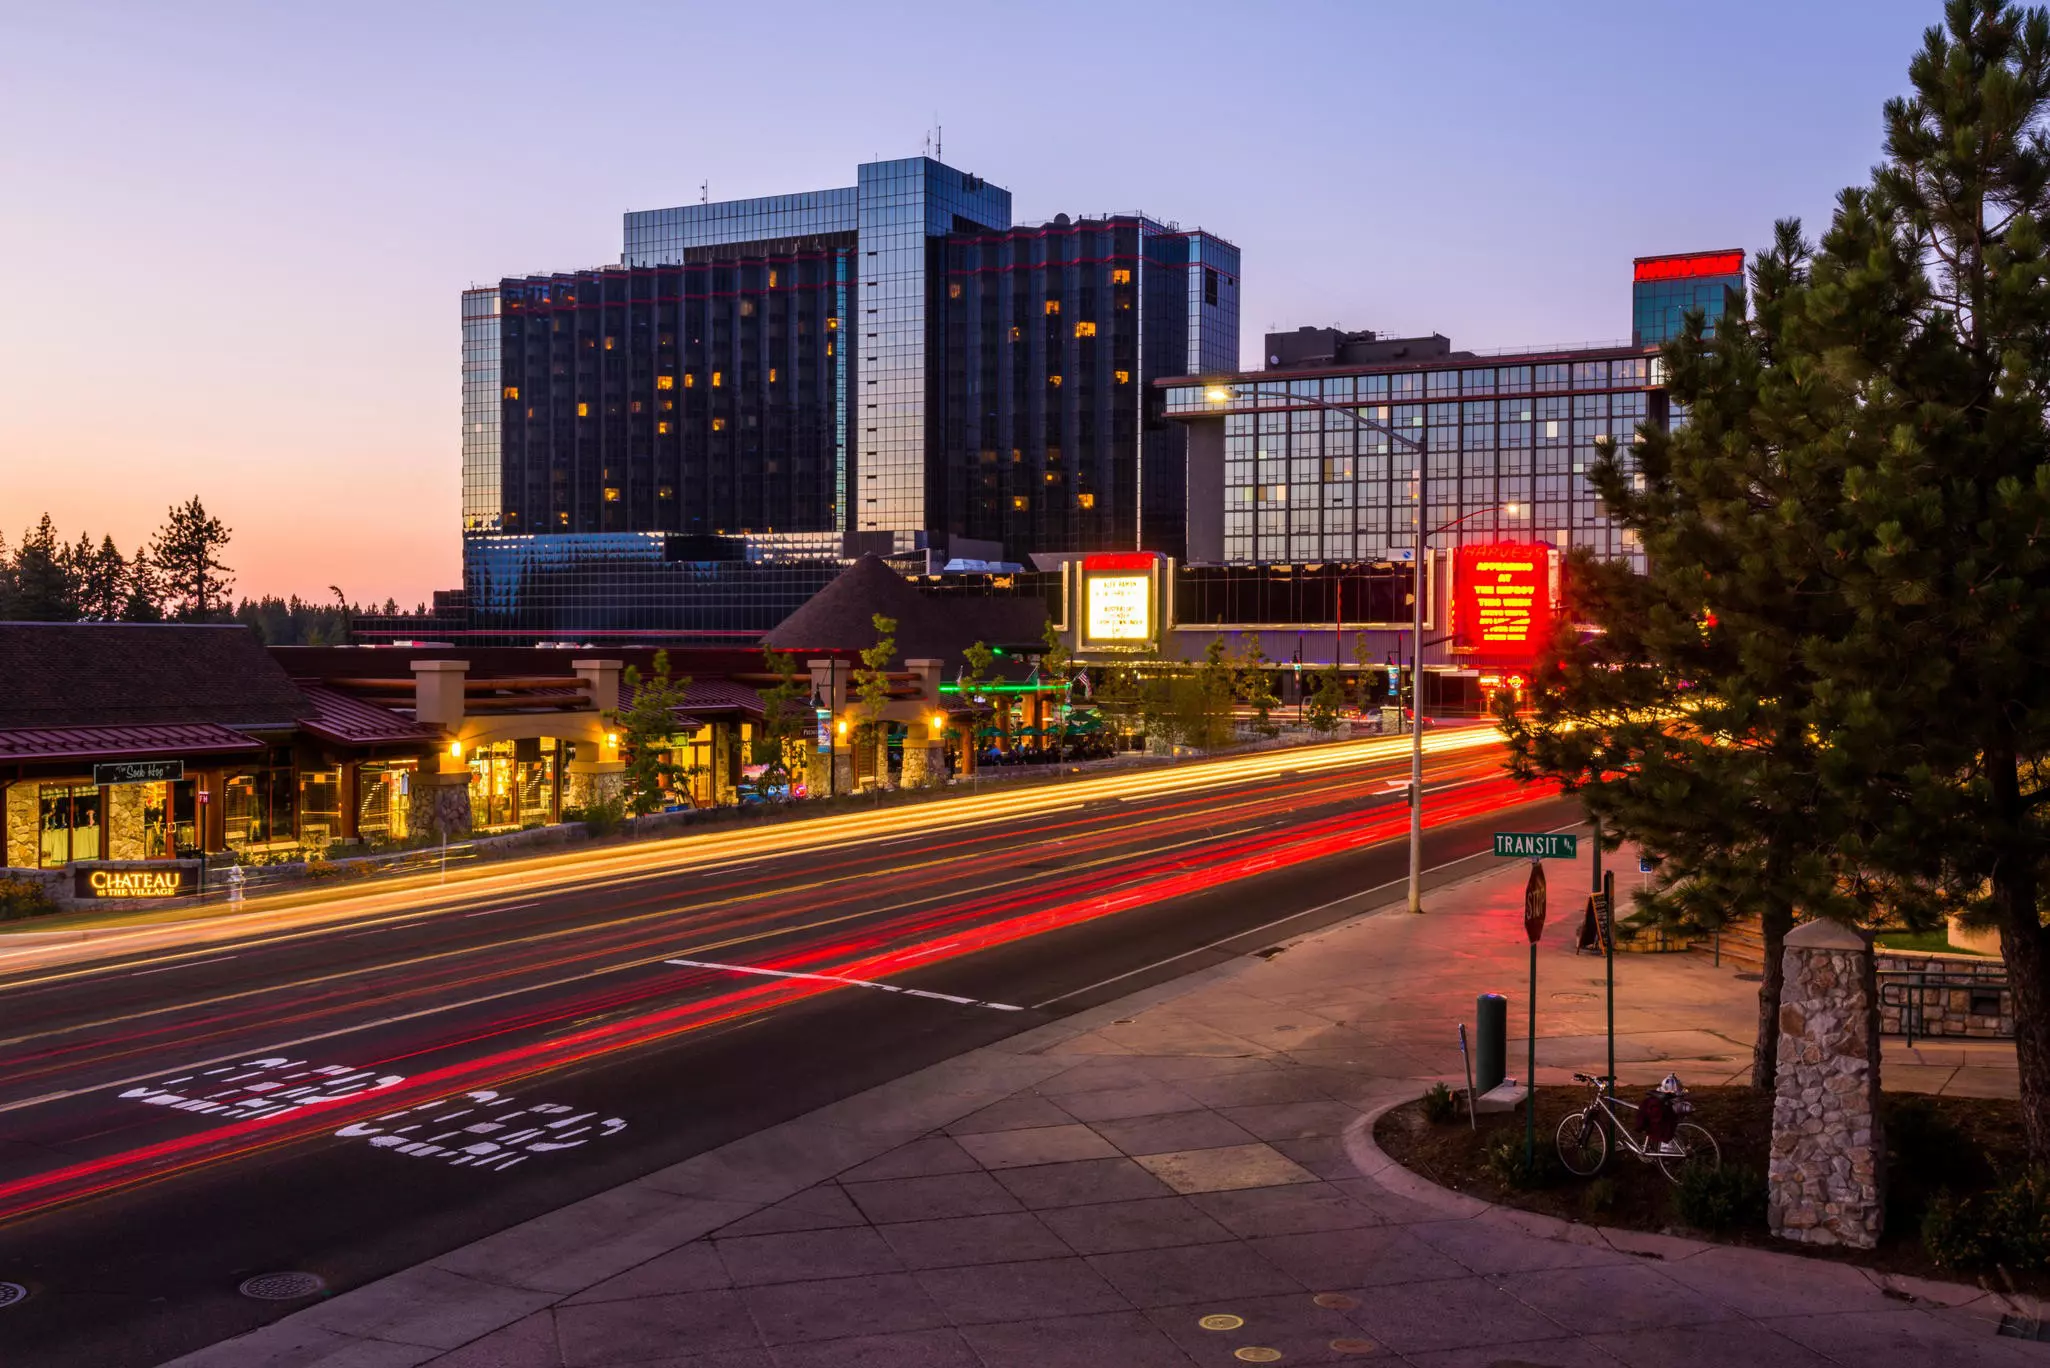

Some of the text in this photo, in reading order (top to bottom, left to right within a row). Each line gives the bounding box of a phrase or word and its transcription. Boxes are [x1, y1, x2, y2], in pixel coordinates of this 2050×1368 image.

[1464, 545, 1544, 558] HARVEYS
[126, 764, 146, 779] Sock
[147, 763, 164, 780] Hop
[1496, 835, 1558, 855] TRANSIT
[90, 871, 180, 889] CHATEAU
[107, 888, 128, 896] THE
[128, 888, 175, 897] VILLAGE
[1526, 888, 1545, 920] STOP
[334, 1090, 628, 1172] CLEAR
